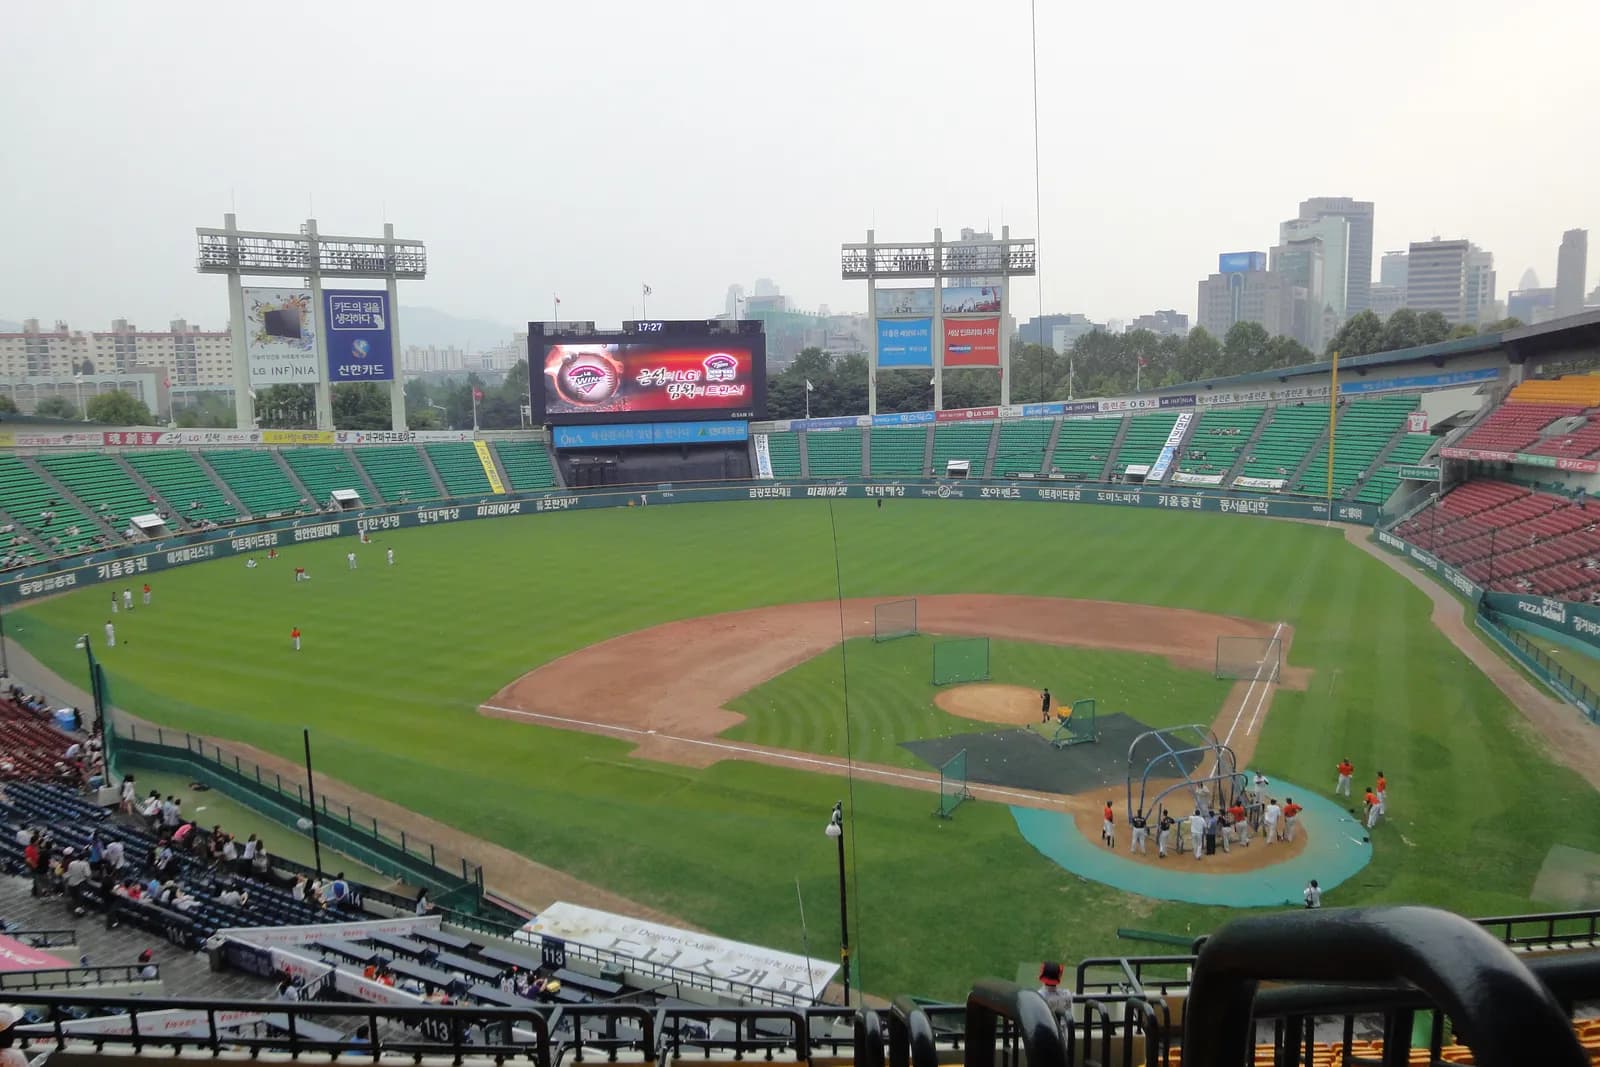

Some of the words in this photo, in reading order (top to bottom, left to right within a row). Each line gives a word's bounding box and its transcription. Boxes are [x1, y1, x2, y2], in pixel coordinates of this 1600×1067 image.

[334, 302, 361, 313] 카드의
[363, 302, 381, 313] 길을
[335, 313, 370, 325] 생각하다
[638, 323, 662, 332] 17:27
[252, 367, 266, 376] LG
[338, 364, 385, 376] 신한카드
[365, 431, 416, 442] 마구마구프로야구
[807, 486, 848, 497] 미래에셋
[865, 486, 905, 497] 현대해상
[980, 487, 1022, 499] 호야렌즈
[1038, 489, 1080, 501] 이트레이드증권
[1097, 491, 1140, 504] 도미노피자
[1158, 495, 1202, 509] 키움증권
[1219, 499, 1270, 515] 동서울대학
[417, 508, 460, 523] 현대해상
[477, 502, 521, 516] 미래에셋
[357, 515, 401, 532] 대한생명
[294, 523, 340, 541] 천안연암대학
[231, 533, 278, 552] 이트레이드증권
[97, 556, 148, 579] 키움증권
[1519, 601, 1542, 616] PIZZA
[543, 948, 563, 965] 113
[423, 1018, 448, 1041] 113
